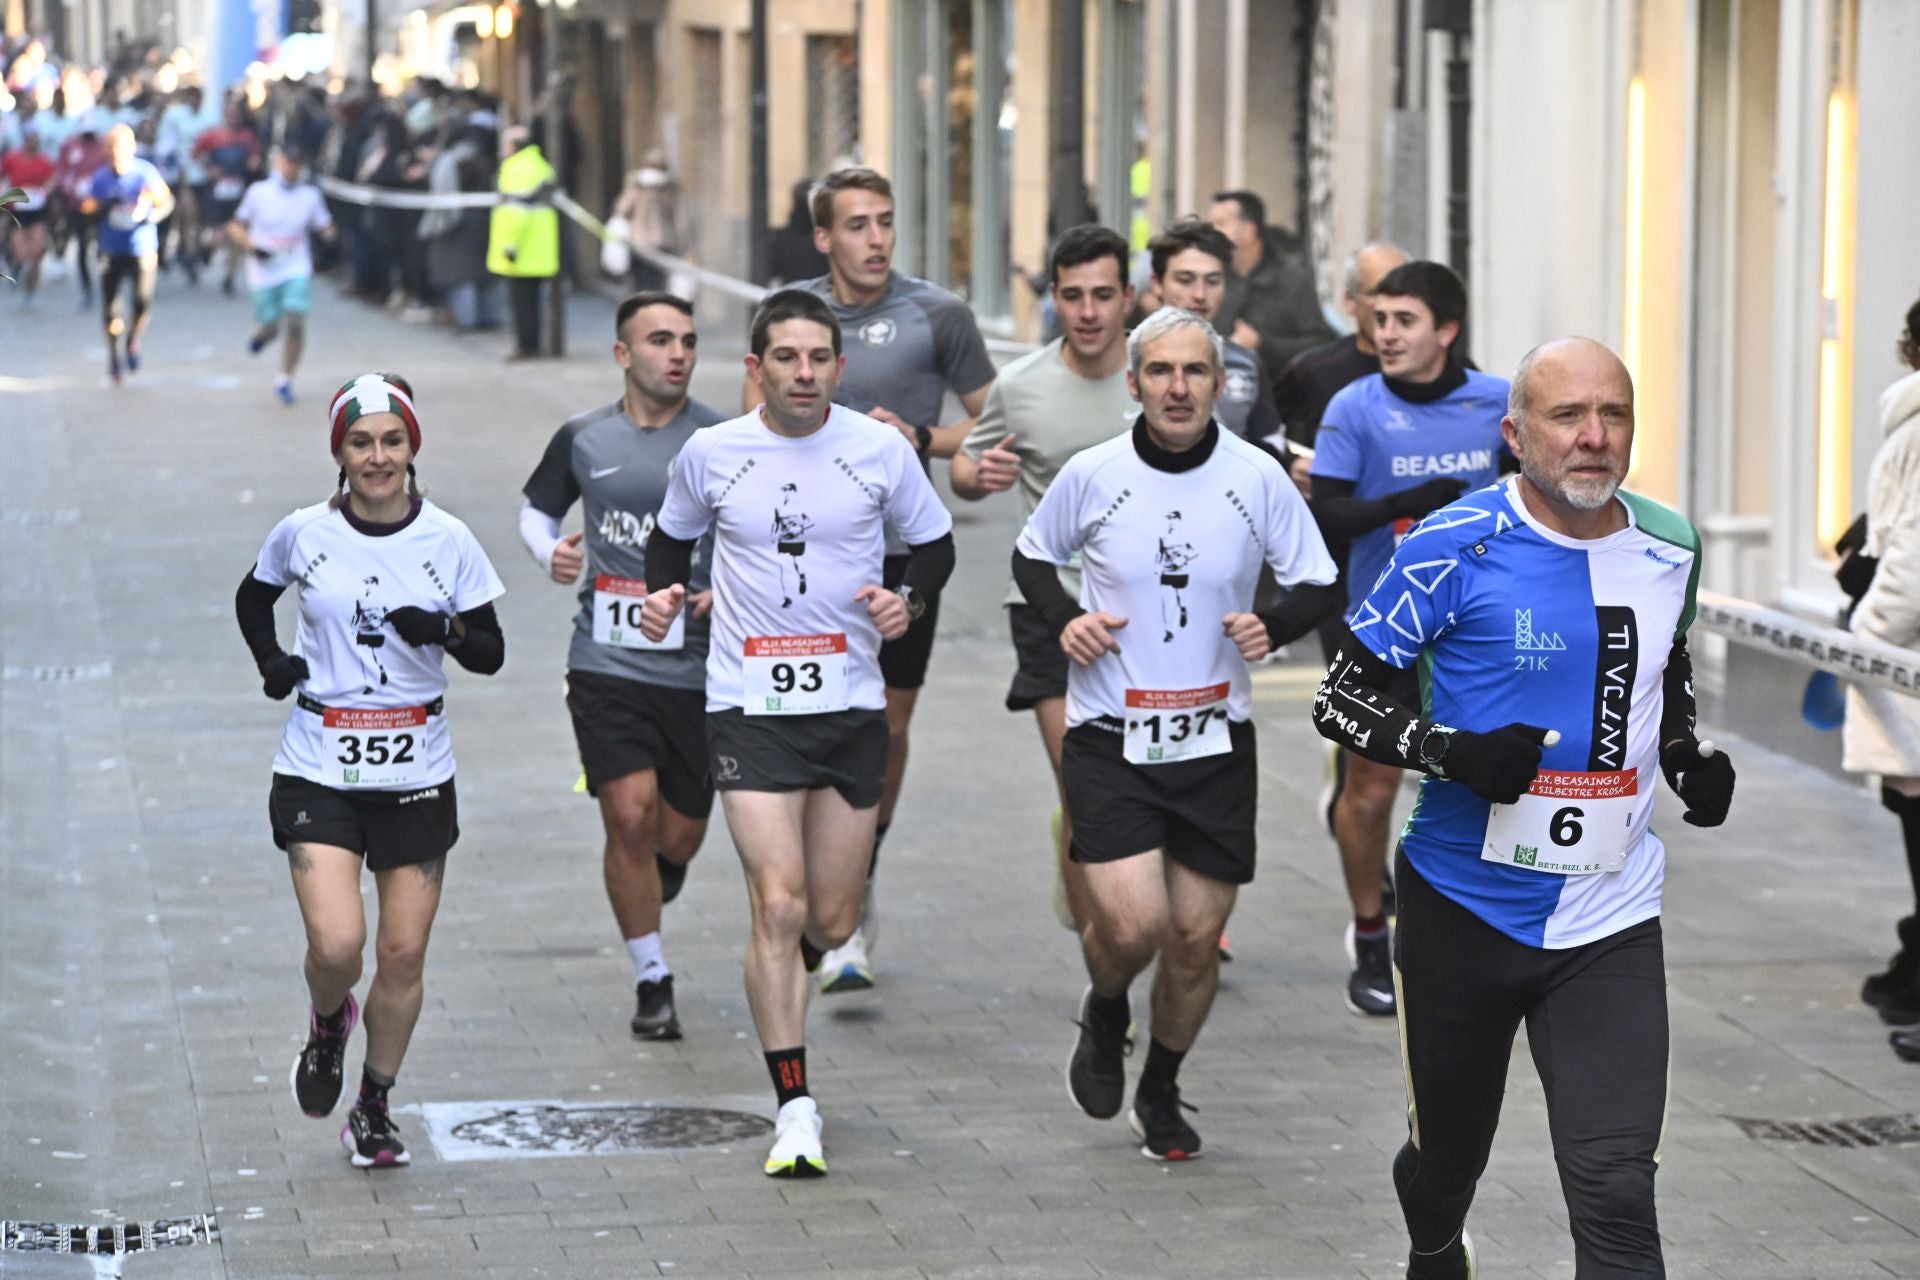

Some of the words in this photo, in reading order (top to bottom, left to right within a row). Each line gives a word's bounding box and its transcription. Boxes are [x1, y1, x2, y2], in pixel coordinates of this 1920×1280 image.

[1391, 449, 1492, 477] BEASAIN
[607, 600, 641, 629] 10
[771, 662, 822, 693] 93
[1514, 656, 1550, 671] 21K
[1143, 707, 1215, 743] 137
[338, 733, 414, 765] 352
[1538, 785, 1593, 797] SILBESTRE
[1596, 786, 1624, 796] KROSA
[1554, 775, 1620, 786] BEASAINGO
[1549, 806, 1585, 847] 6
